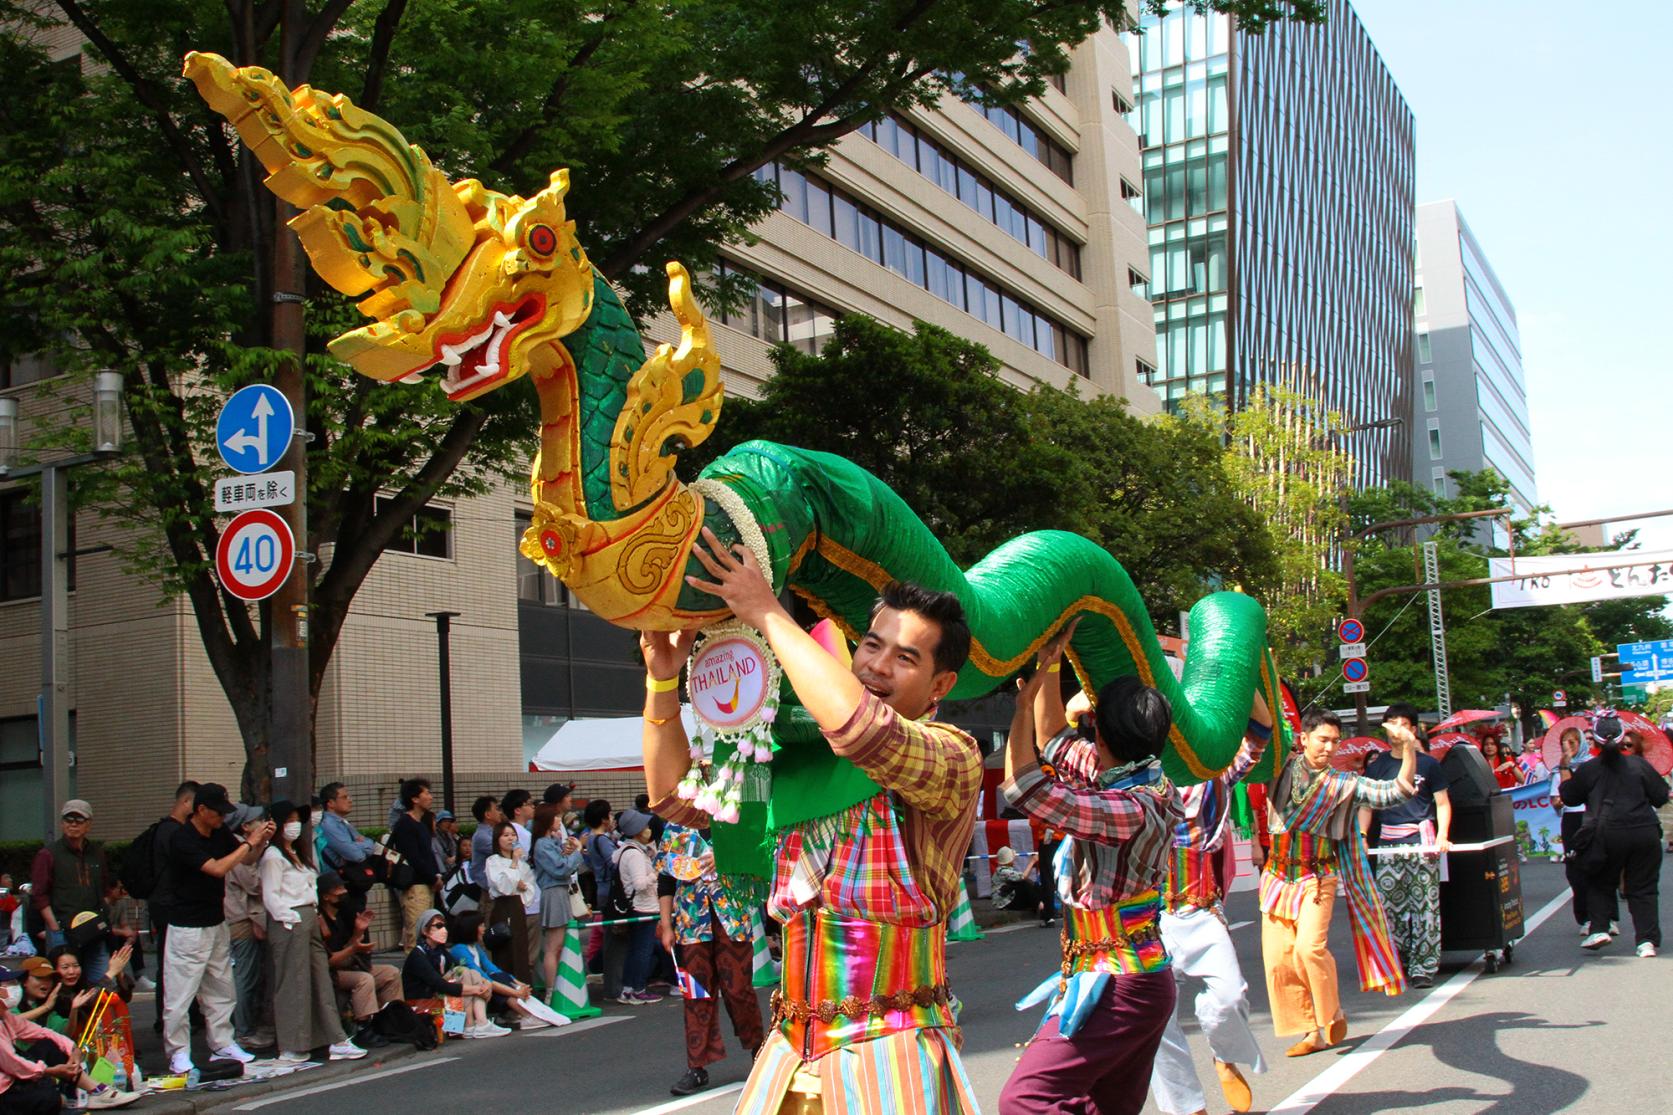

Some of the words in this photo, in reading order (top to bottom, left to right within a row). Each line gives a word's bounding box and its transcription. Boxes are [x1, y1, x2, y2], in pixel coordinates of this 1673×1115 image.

[221, 480, 288, 504] 軽車両を除く
[234, 534, 275, 575] 40
[704, 649, 734, 668] amazing
[692, 656, 756, 693] THAILAND
[1512, 796, 1553, 810] のLC
